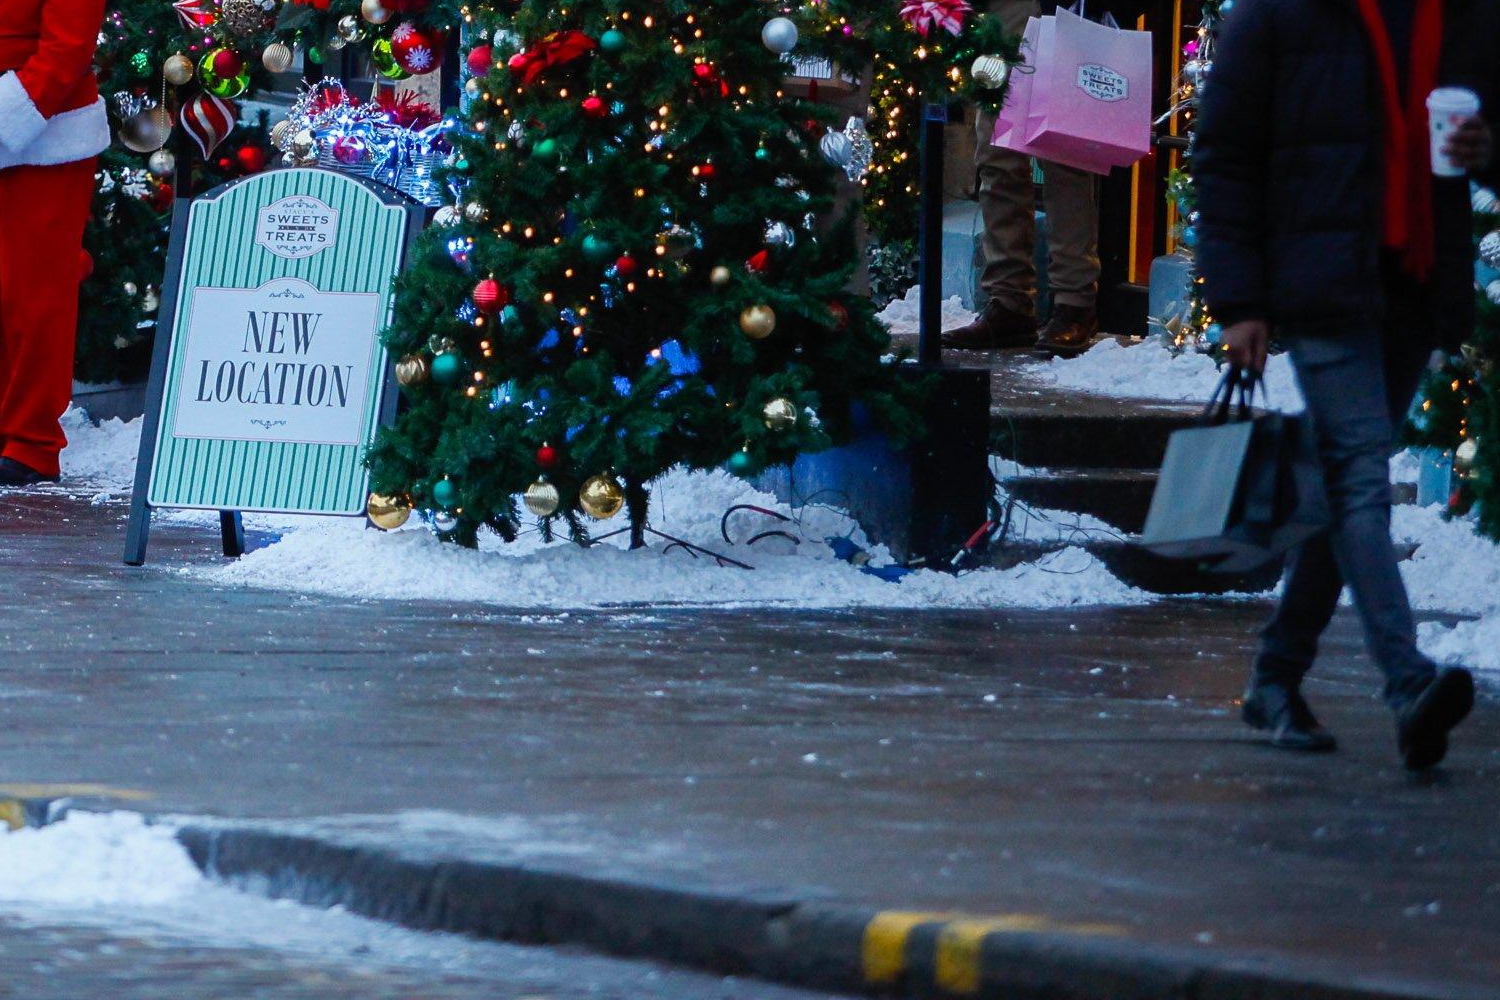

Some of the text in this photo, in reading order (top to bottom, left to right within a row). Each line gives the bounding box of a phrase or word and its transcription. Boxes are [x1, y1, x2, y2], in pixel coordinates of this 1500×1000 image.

[1082, 69, 1123, 85] SWEETS
[1082, 79, 1123, 95] TREATS
[267, 214, 329, 225] SWEETS
[265, 231, 327, 243] TREATS
[241, 310, 323, 355] NEW
[195, 359, 354, 408] LOCATION
